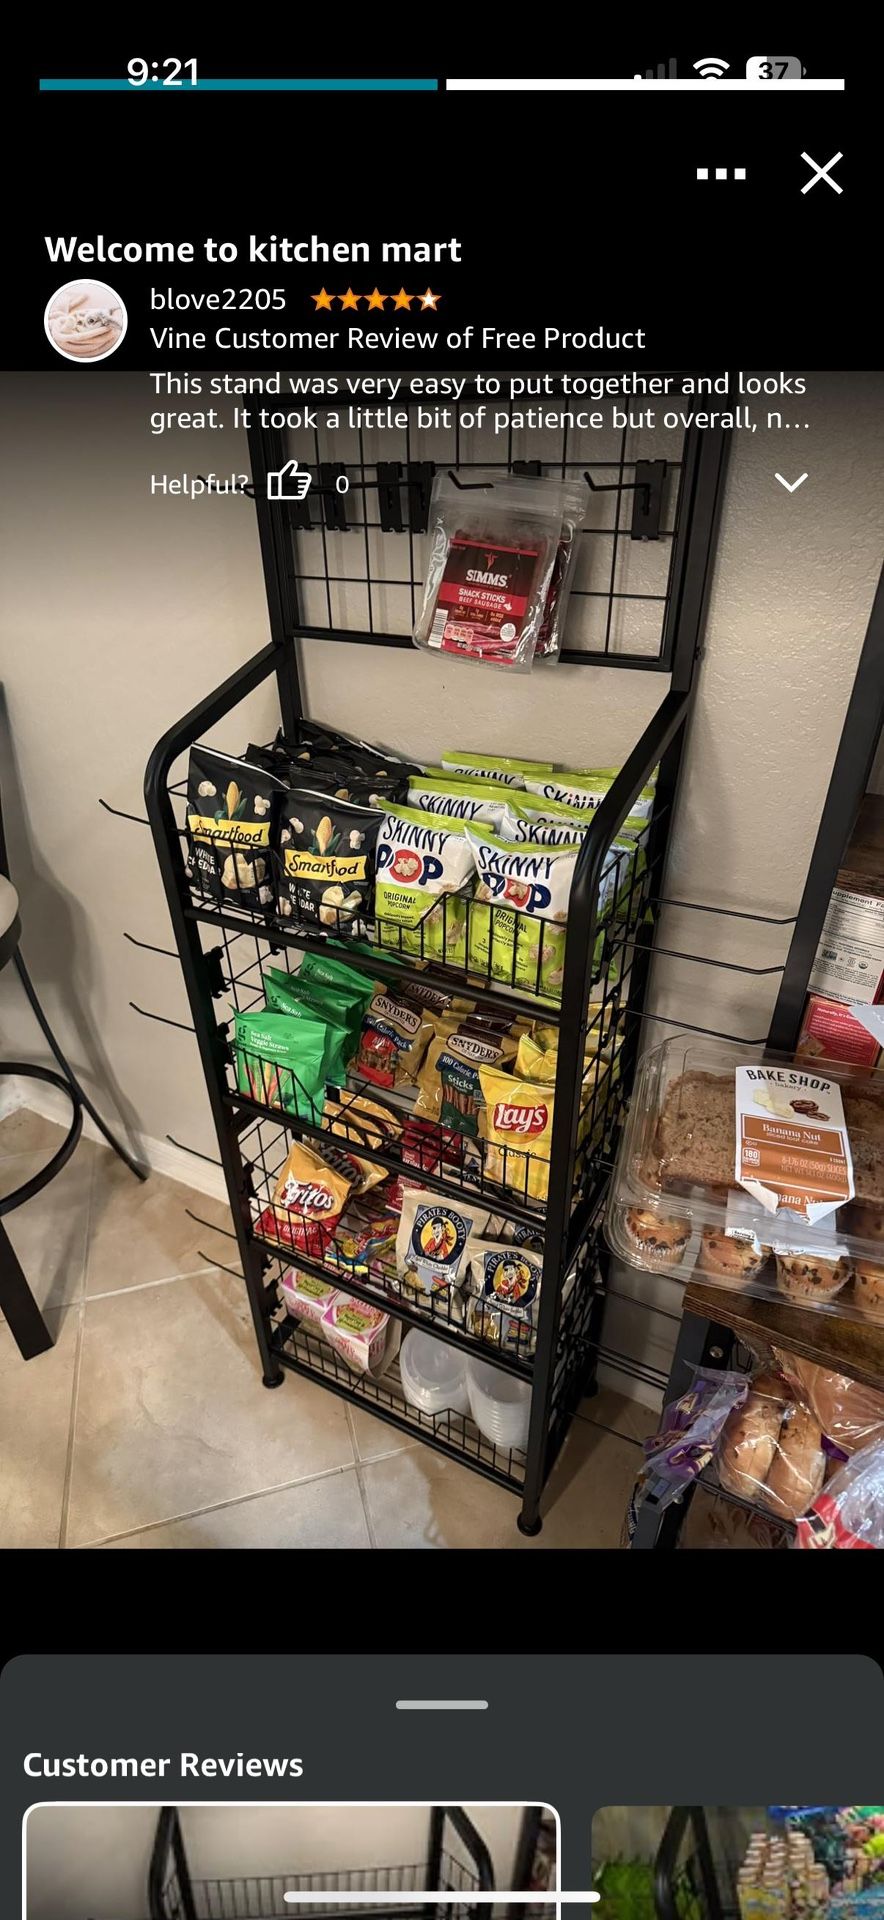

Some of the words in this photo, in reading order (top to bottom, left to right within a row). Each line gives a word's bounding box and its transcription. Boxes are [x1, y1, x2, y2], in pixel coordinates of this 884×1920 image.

[459, 588, 480, 599] SNACK
[481, 592, 506, 604] STICKS
[474, 599, 502, 610] SAUSAGE
[382, 815, 450, 855] SKINNY
[478, 845, 560, 879] SKINNY
[384, 891, 416, 904] ORIGINAL
[387, 901, 410, 910] POPCORN
[832, 890, 873, 906] upplement
[442, 1055, 453, 1066] 100
[453, 1062, 471, 1078] Calorie
[447, 1074, 474, 1091] Sticks
[746, 1069, 786, 1082] BAKE
[788, 1074, 831, 1092] SHOP
[775, 1082, 801, 1091] bakery
[495, 1103, 546, 1133] Lay's
[762, 1123, 801, 1138] Banana
[803, 1131, 821, 1141] Nut
[744, 1149, 758, 1159] 180
[826, 1164, 846, 1176] SLICES
[283, 1171, 333, 1212] Fritos
[447, 1212, 467, 1241] BOOTY
